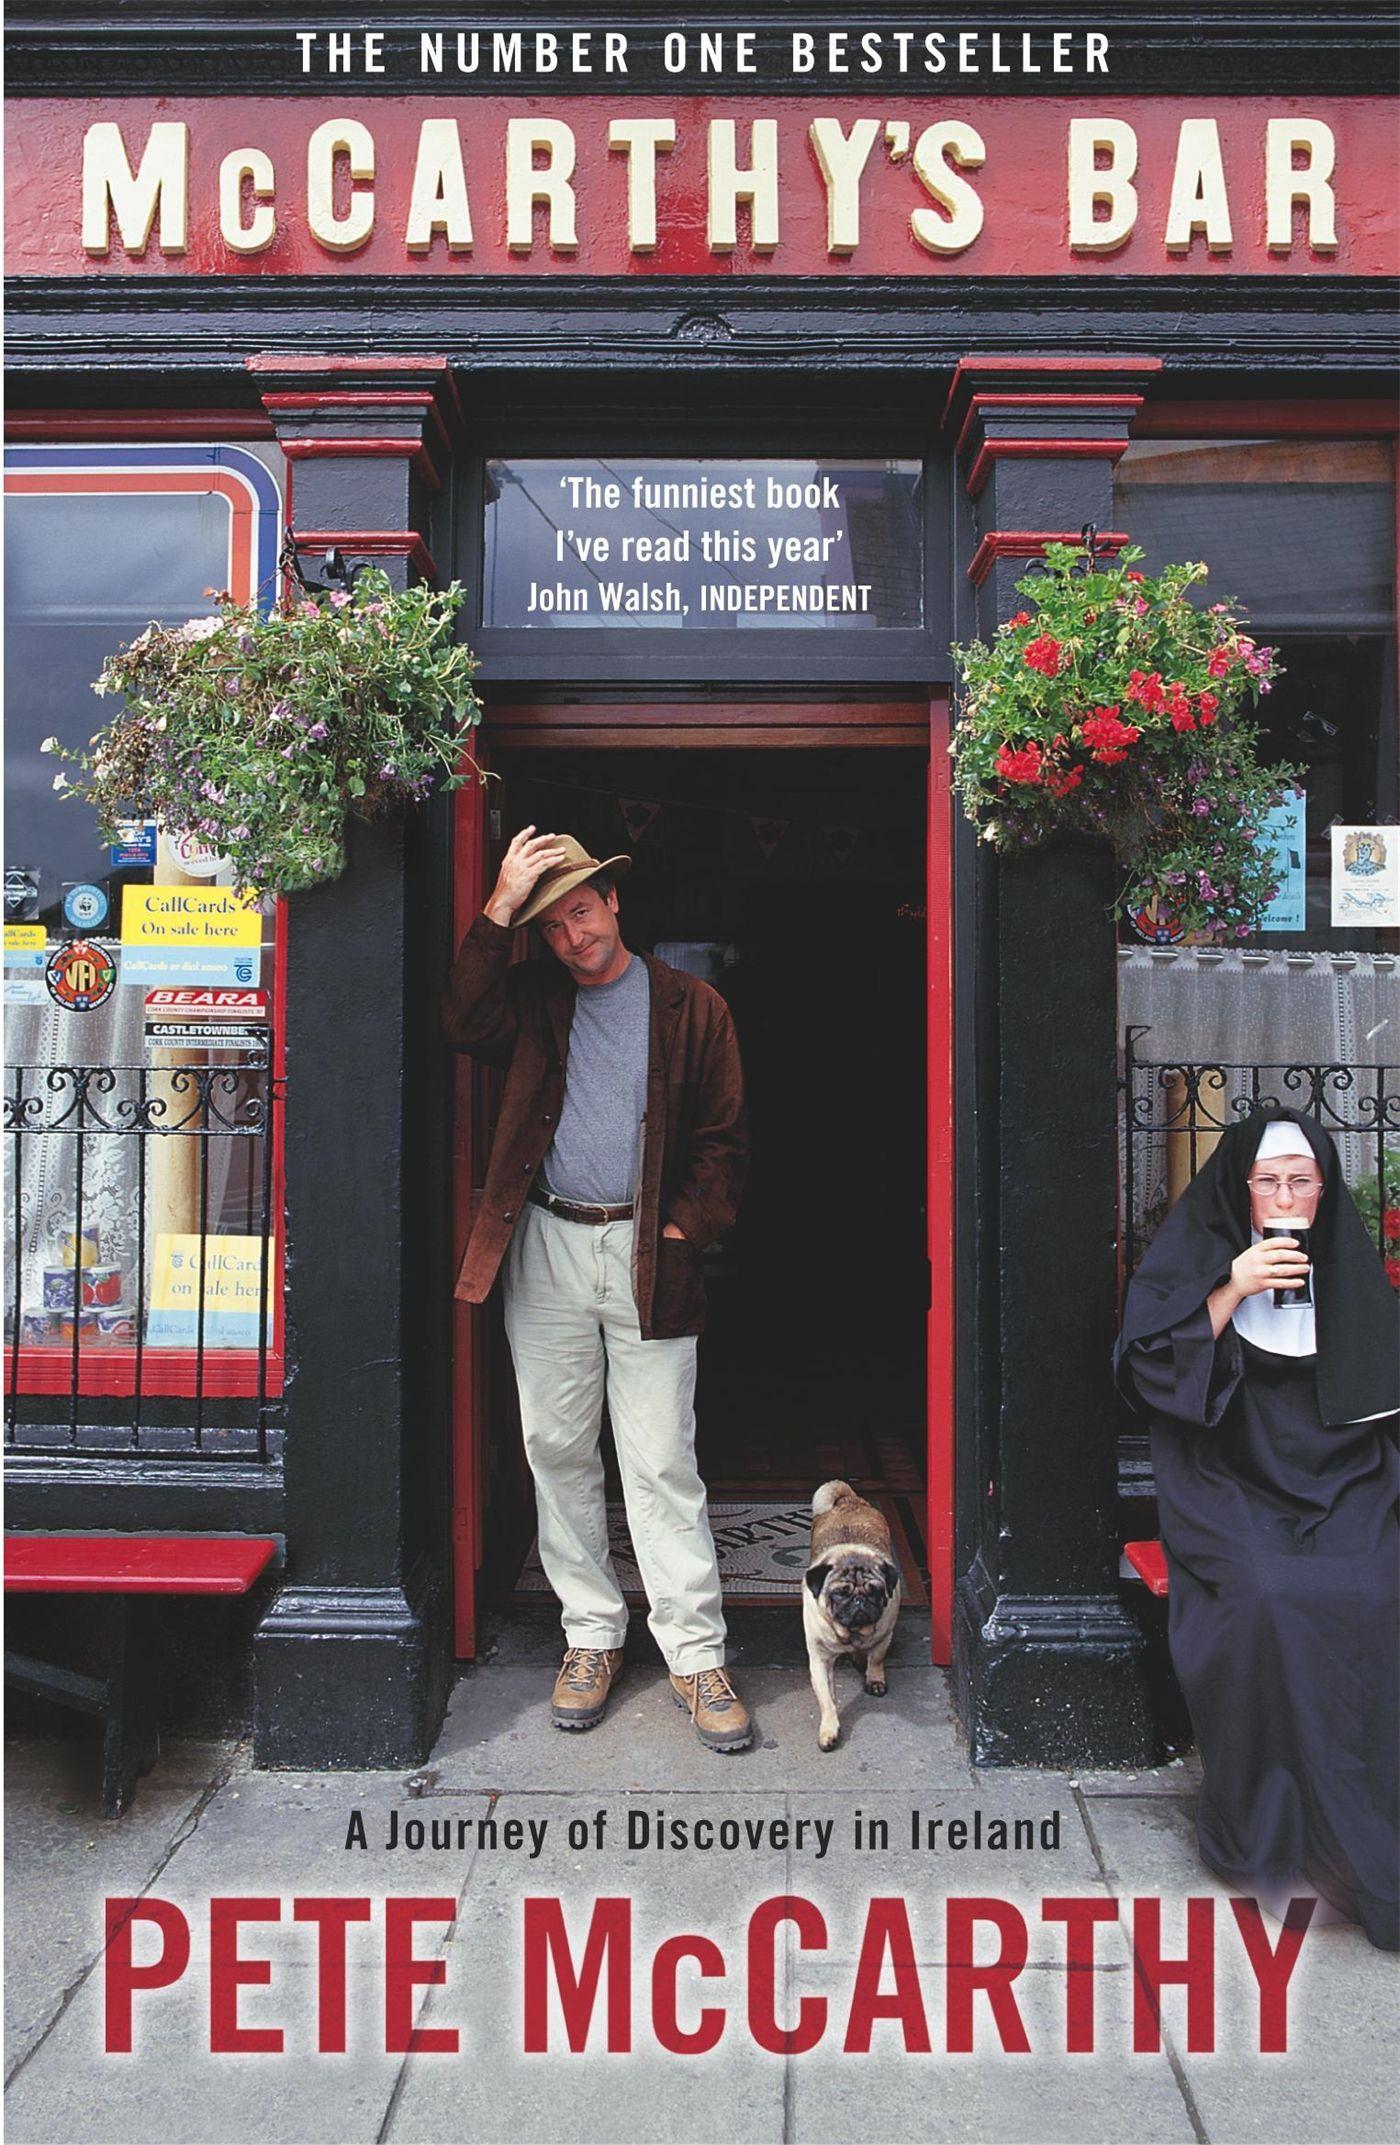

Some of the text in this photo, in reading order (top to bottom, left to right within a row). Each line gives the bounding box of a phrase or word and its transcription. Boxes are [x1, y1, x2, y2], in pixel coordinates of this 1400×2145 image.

[80, 116, 1341, 258] McCARTHY'S BAR
[145, 896, 236, 914] CallCards
[141, 921, 239, 937] On sale here
[65, 959, 97, 993] VFI
[151, 990, 259, 1005] BEARA
[152, 1024, 251, 1036] CASTLETOWNBE
[189, 1254, 262, 1272] CllCard
[171, 1281, 270, 1297] on ale her
